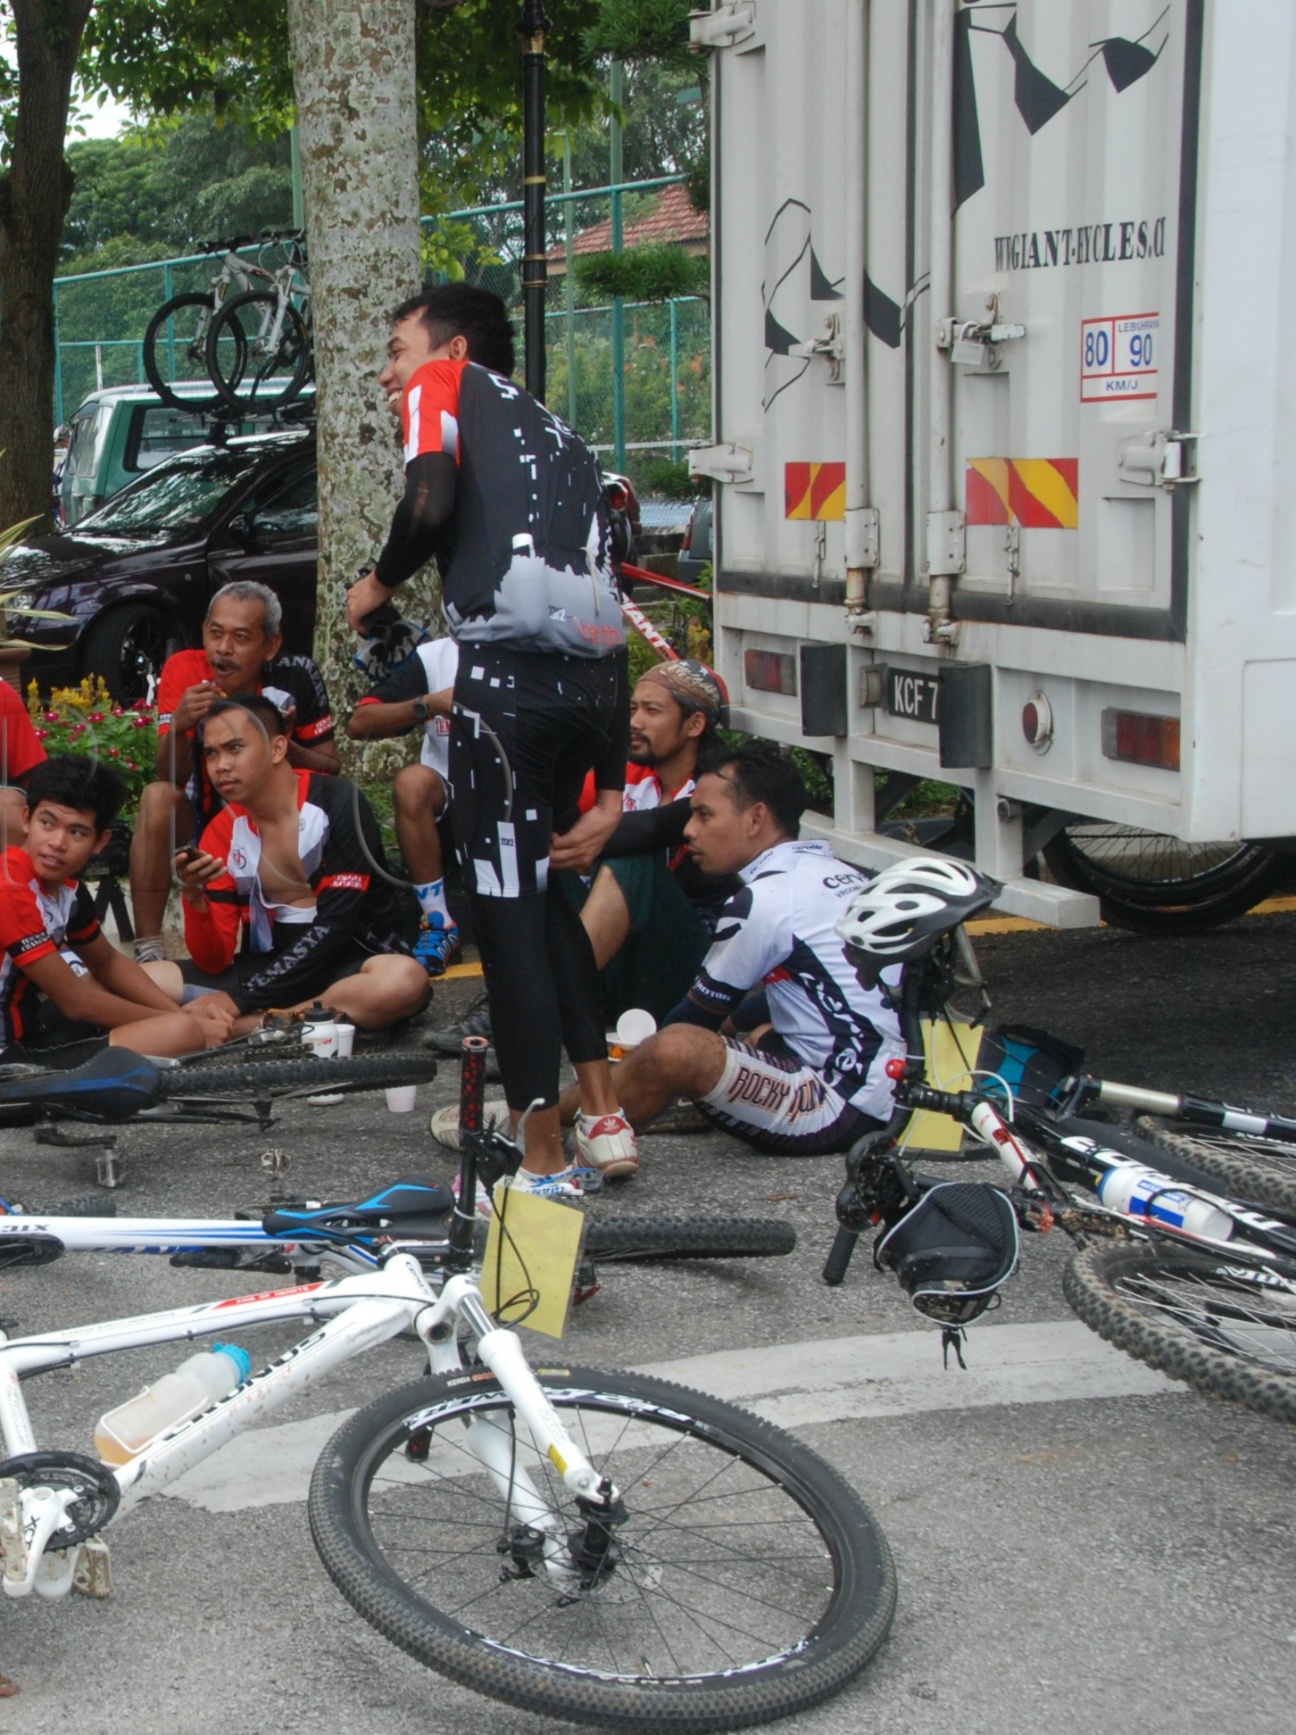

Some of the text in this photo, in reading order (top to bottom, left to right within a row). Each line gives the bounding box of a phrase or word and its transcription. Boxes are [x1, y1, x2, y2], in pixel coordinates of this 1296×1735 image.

[1085, 330, 1153, 368] 80 90
[1106, 379, 1138, 391] KM/J
[894, 675, 939, 720] KCF 7
[725, 1064, 791, 1114] ROCKY
